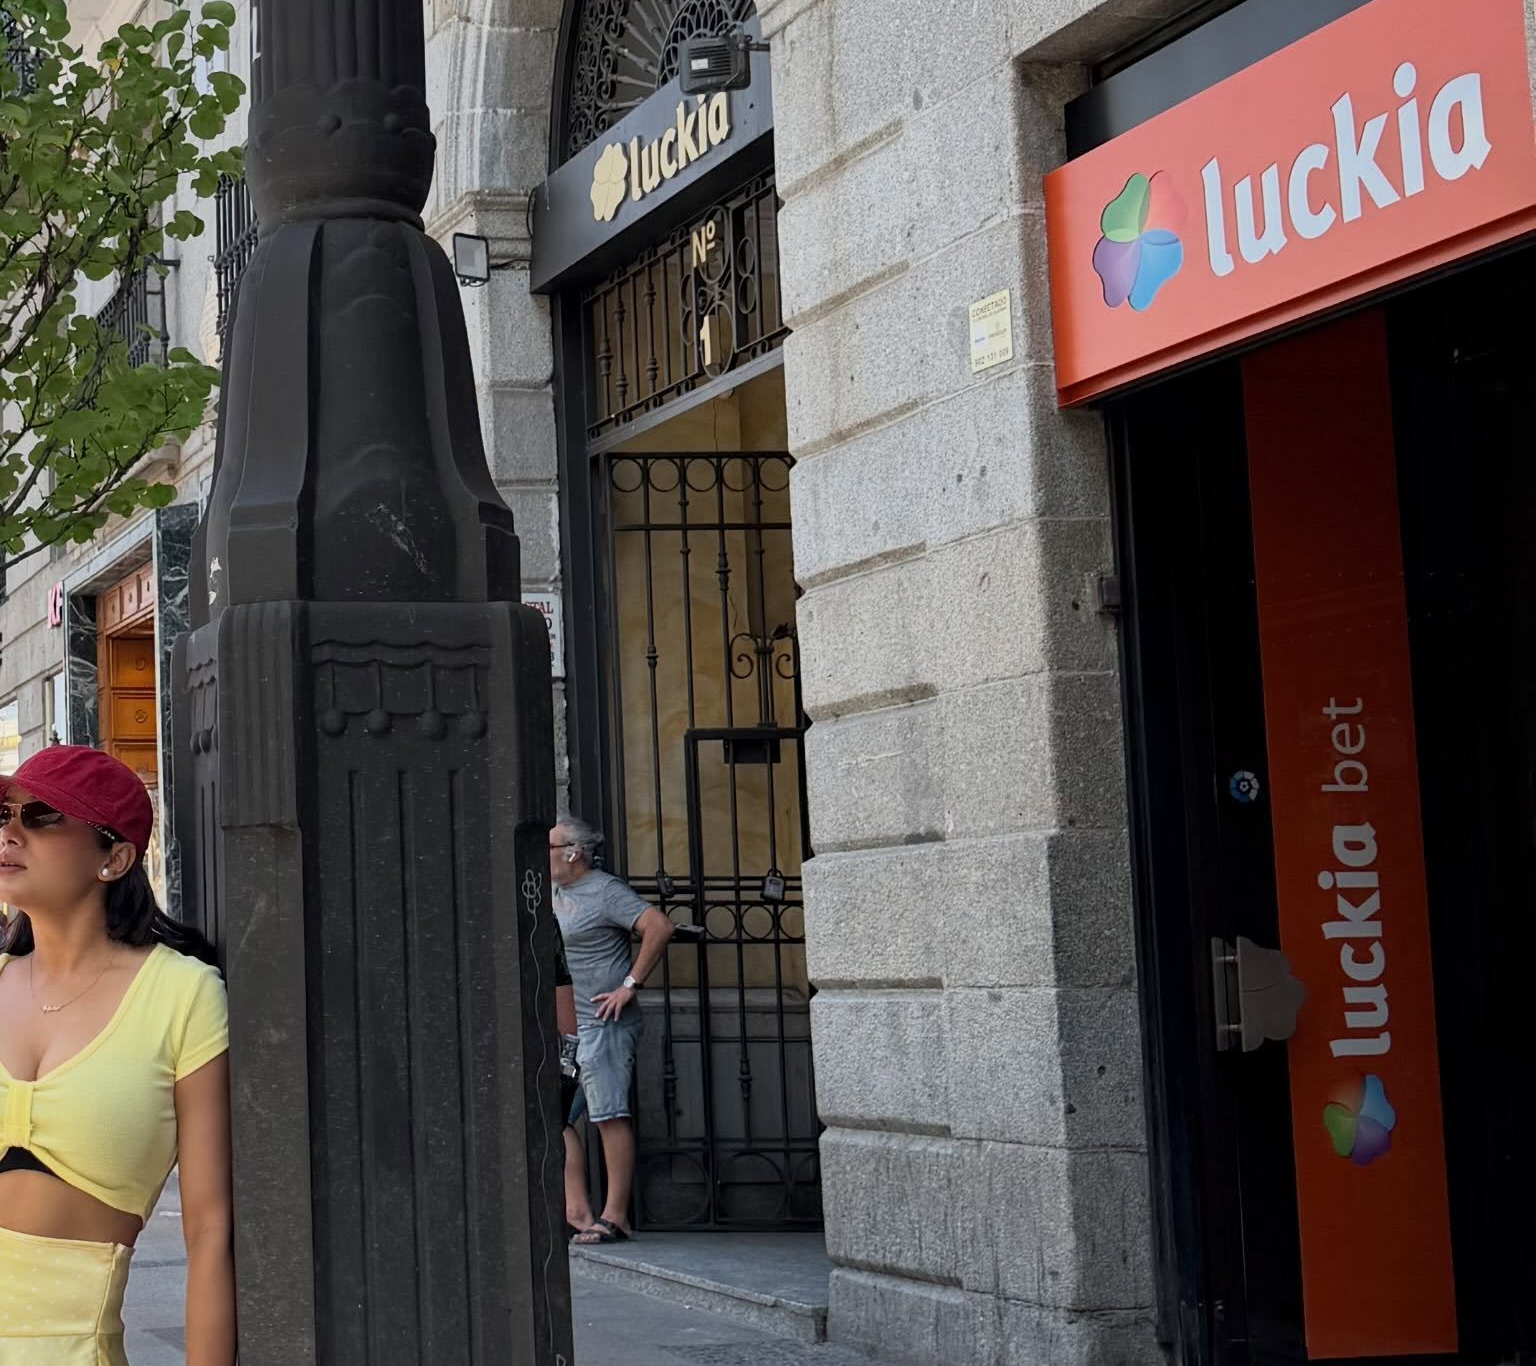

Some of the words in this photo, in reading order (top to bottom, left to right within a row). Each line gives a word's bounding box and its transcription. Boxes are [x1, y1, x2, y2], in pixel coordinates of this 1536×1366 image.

[628, 92, 731, 202] luckia
[1200, 62, 1492, 277] luckia
[700, 314, 711, 366] 1
[1321, 696, 1369, 792] bet
[1317, 821, 1391, 1059] luckia
